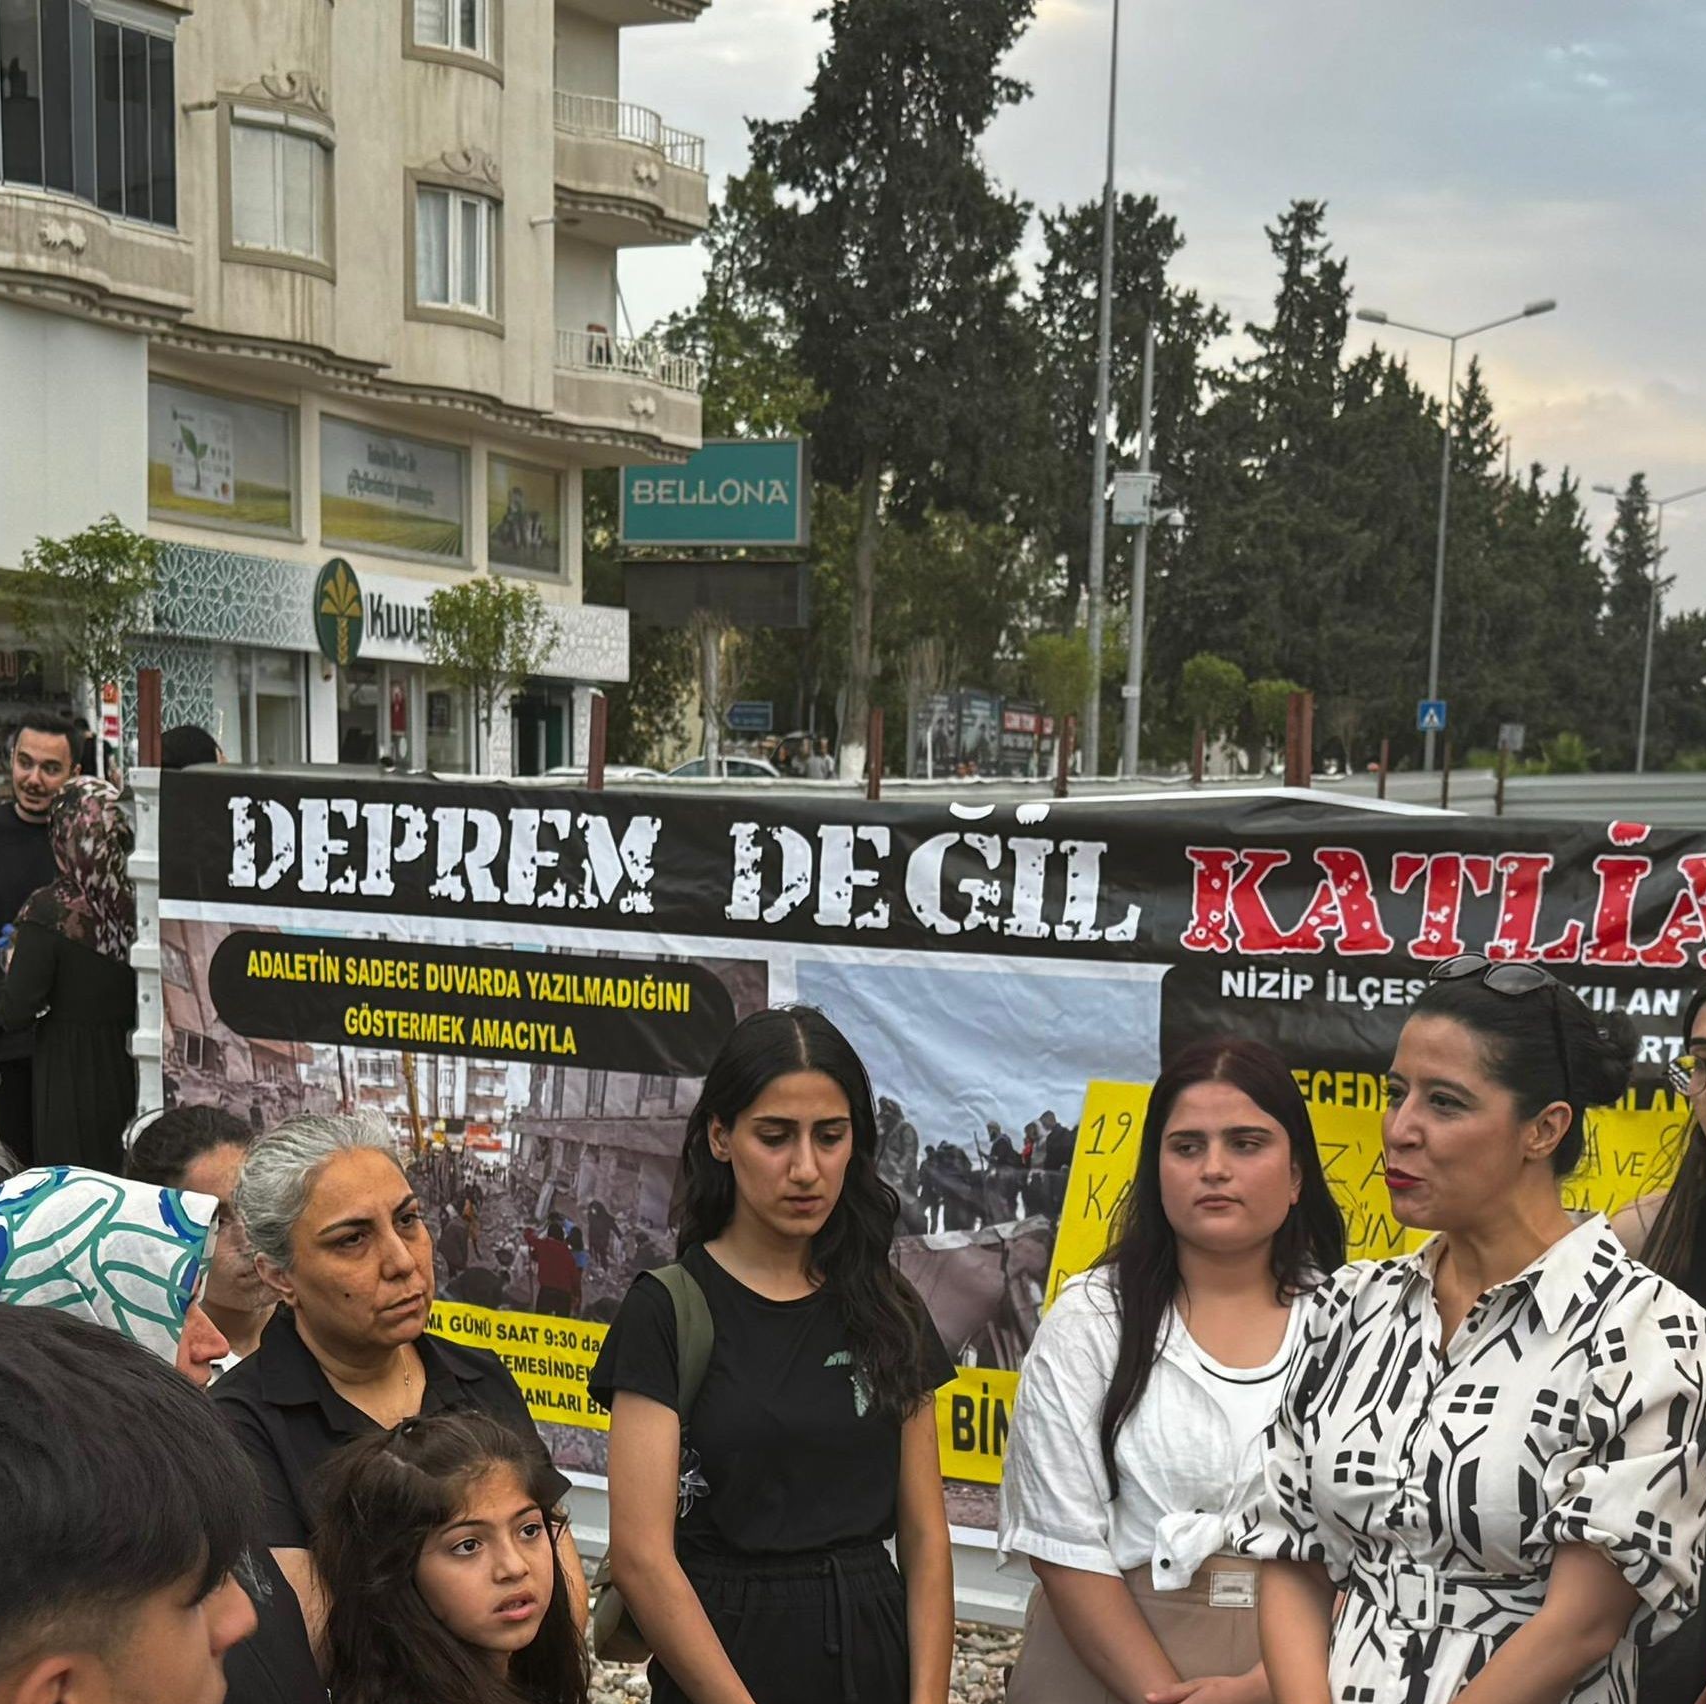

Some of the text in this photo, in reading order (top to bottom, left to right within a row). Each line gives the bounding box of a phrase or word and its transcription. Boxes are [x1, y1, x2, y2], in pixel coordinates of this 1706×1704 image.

[631, 478, 789, 506] BELLONA
[227, 794, 662, 915] DEPREM
[725, 801, 1142, 944] DEĞİL
[246, 947, 691, 1014] ADALETİN SADECE DUVARDA YAZILMADIĞINI
[1220, 965, 1314, 1002] NİZİP
[1325, 969, 1433, 1012] İLÇES
[343, 1005, 578, 1055] GÖSTERMEK AMACIYLA
[1084, 1111, 1133, 1156] 19
[449, 1313, 492, 1338] GÜNÜ
[496, 1323, 539, 1344] SAAT
[544, 1328, 577, 1350] 9:30
